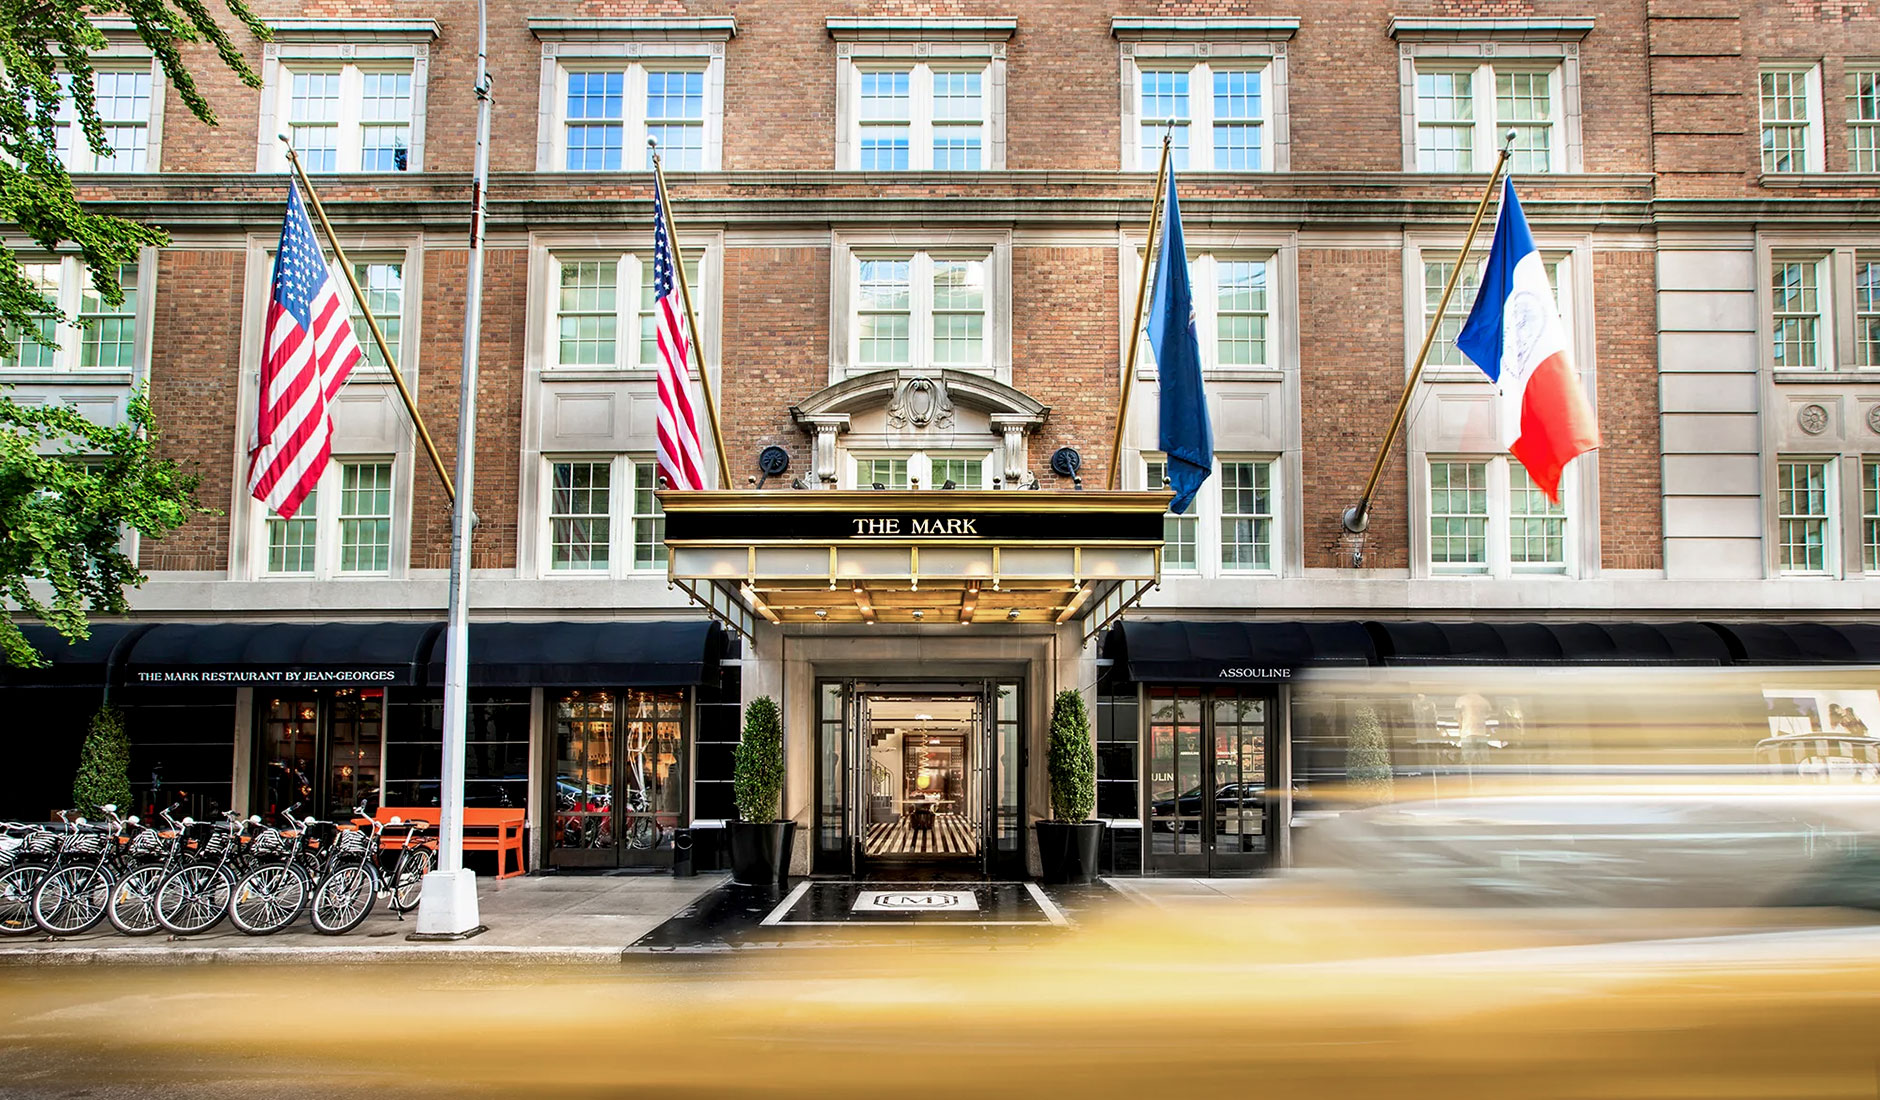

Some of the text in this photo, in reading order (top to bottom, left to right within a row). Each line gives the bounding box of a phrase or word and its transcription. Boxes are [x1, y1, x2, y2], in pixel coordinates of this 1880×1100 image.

[852, 518, 978, 534] THE MARK
[137, 670, 395, 682] THE MARK RESTAURANT BY JEAN-GEORGES
[1218, 667, 1291, 678] ASSOULINE
[1151, 772, 1174, 782] ULIN
[901, 896, 933, 904] M
